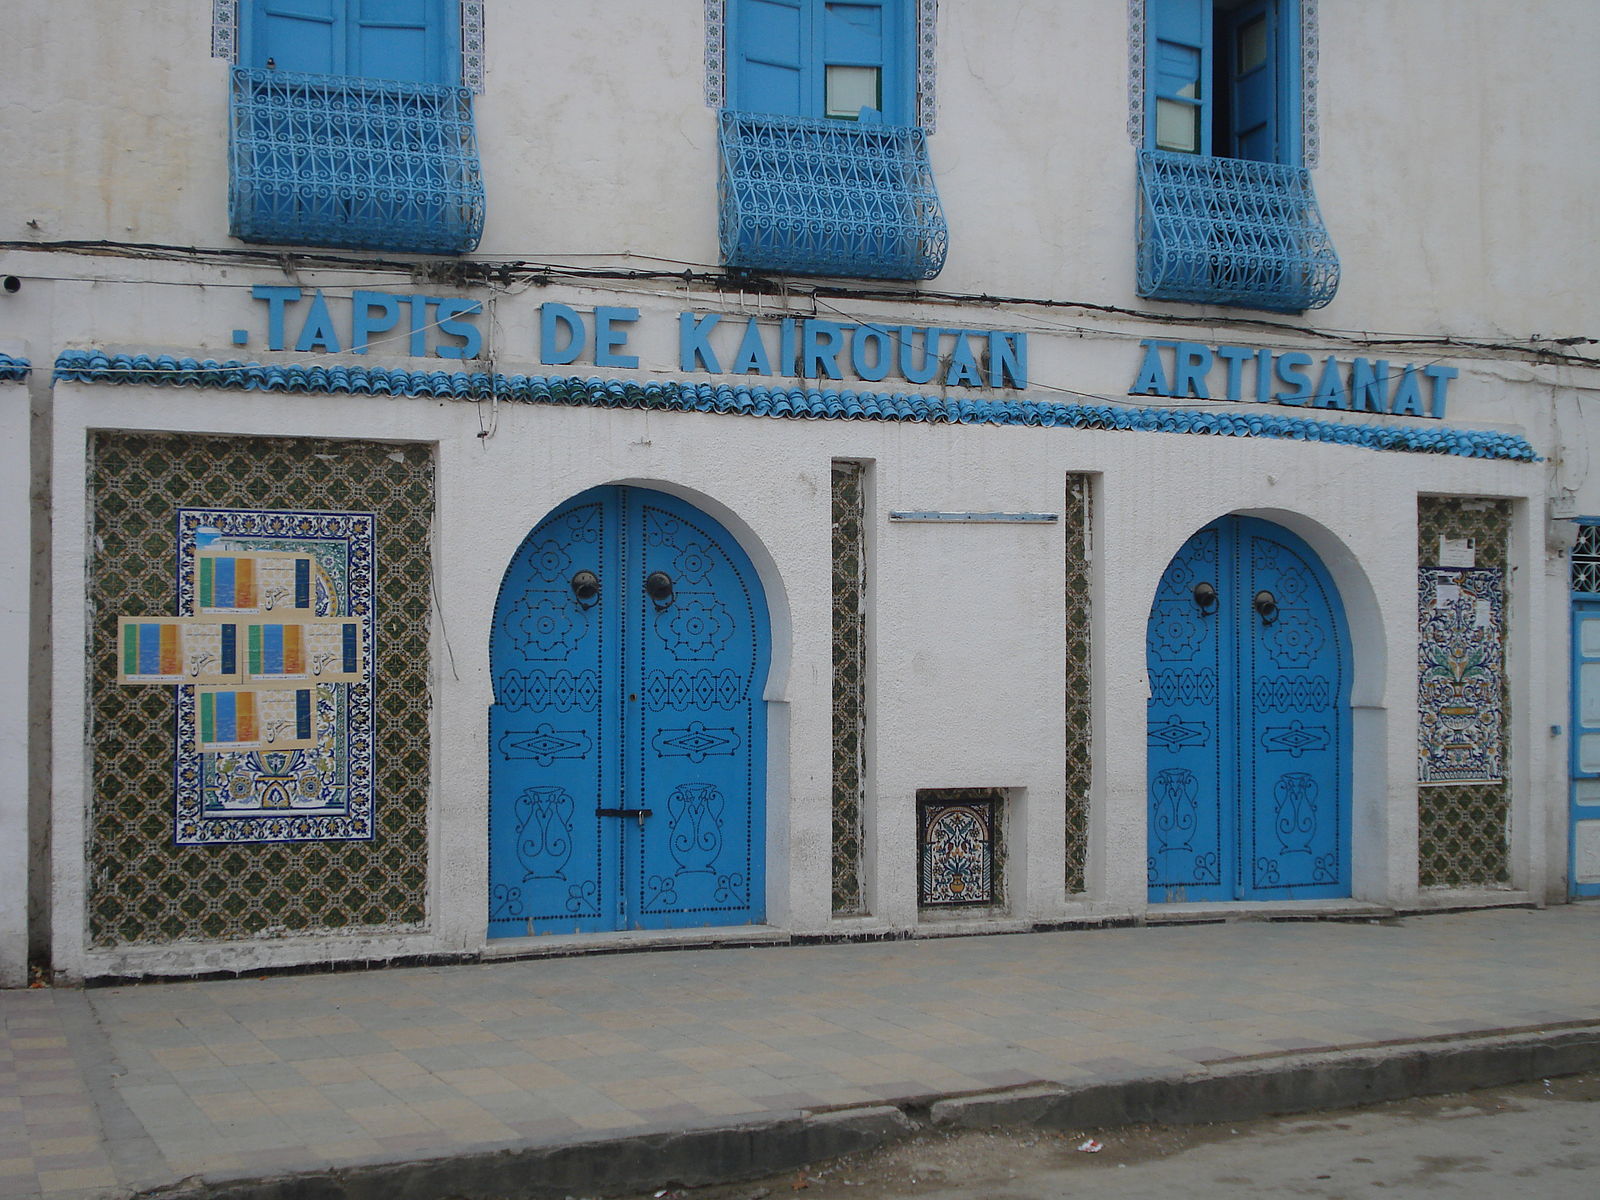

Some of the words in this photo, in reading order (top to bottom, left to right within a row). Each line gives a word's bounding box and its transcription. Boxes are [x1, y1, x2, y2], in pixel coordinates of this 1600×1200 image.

[540, 302, 640, 369] DE
[679, 312, 1028, 390] KAIROUAN
[1128, 339, 1459, 419] ARTISANAT
